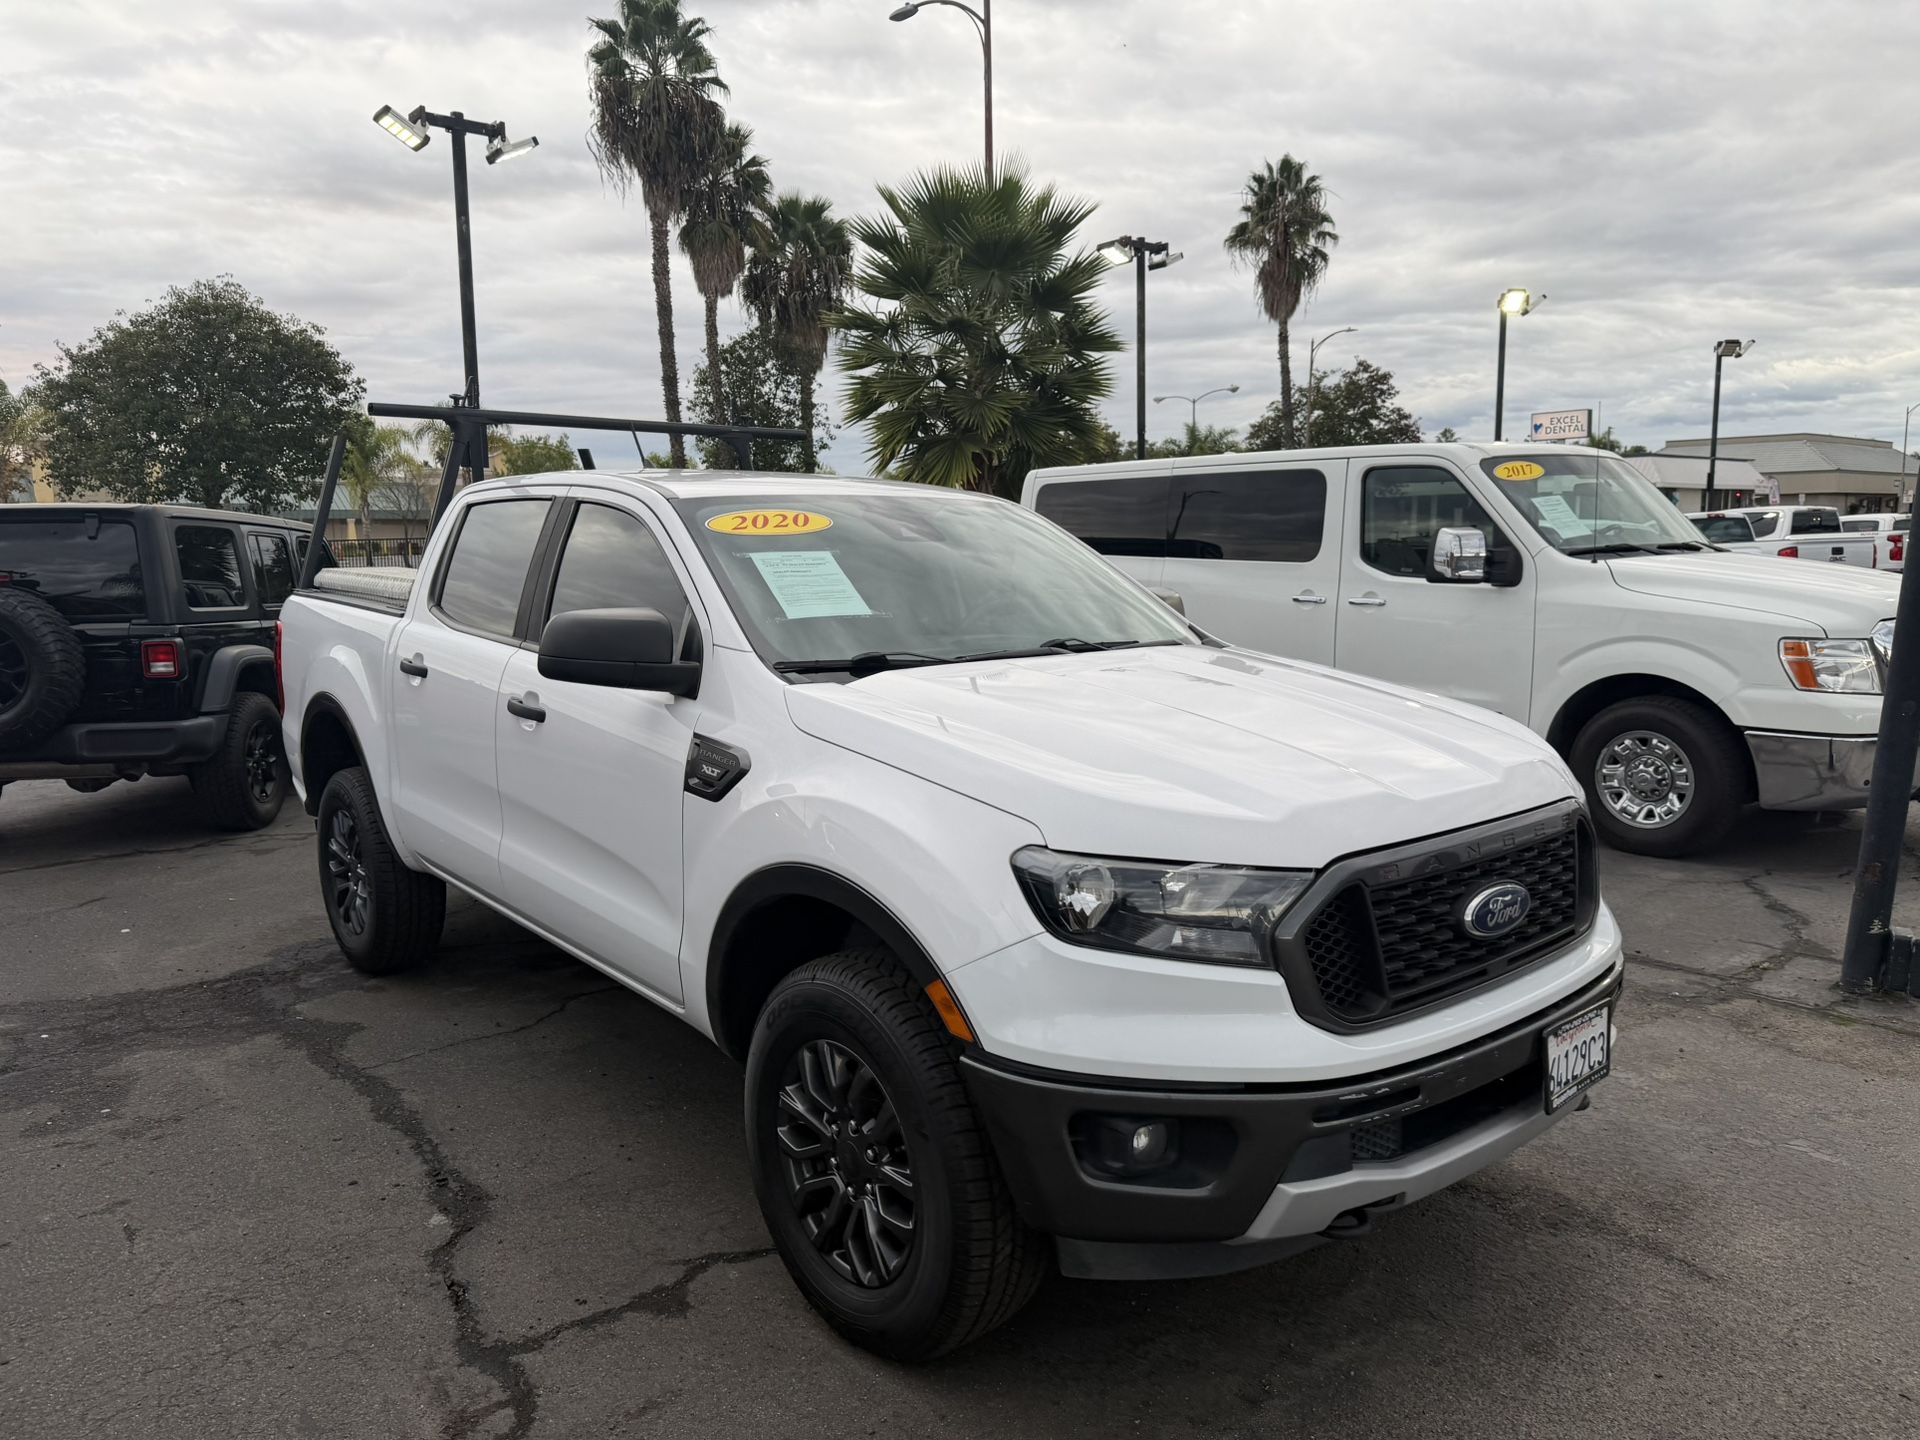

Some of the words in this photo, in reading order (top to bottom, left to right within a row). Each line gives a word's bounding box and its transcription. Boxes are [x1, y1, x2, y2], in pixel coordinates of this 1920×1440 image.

[1545, 423, 1585, 435] DENTAL
[1550, 415, 1581, 426] EXCEL
[1503, 464, 1534, 478] 2017
[731, 512, 810, 531] 2020
[699, 749, 737, 767] RANGER
[701, 764, 721, 777] XLT
[1381, 813, 1572, 880] RANGER
[1487, 894, 1521, 927] Ford
[1549, 1031, 1606, 1093] 64129C3
